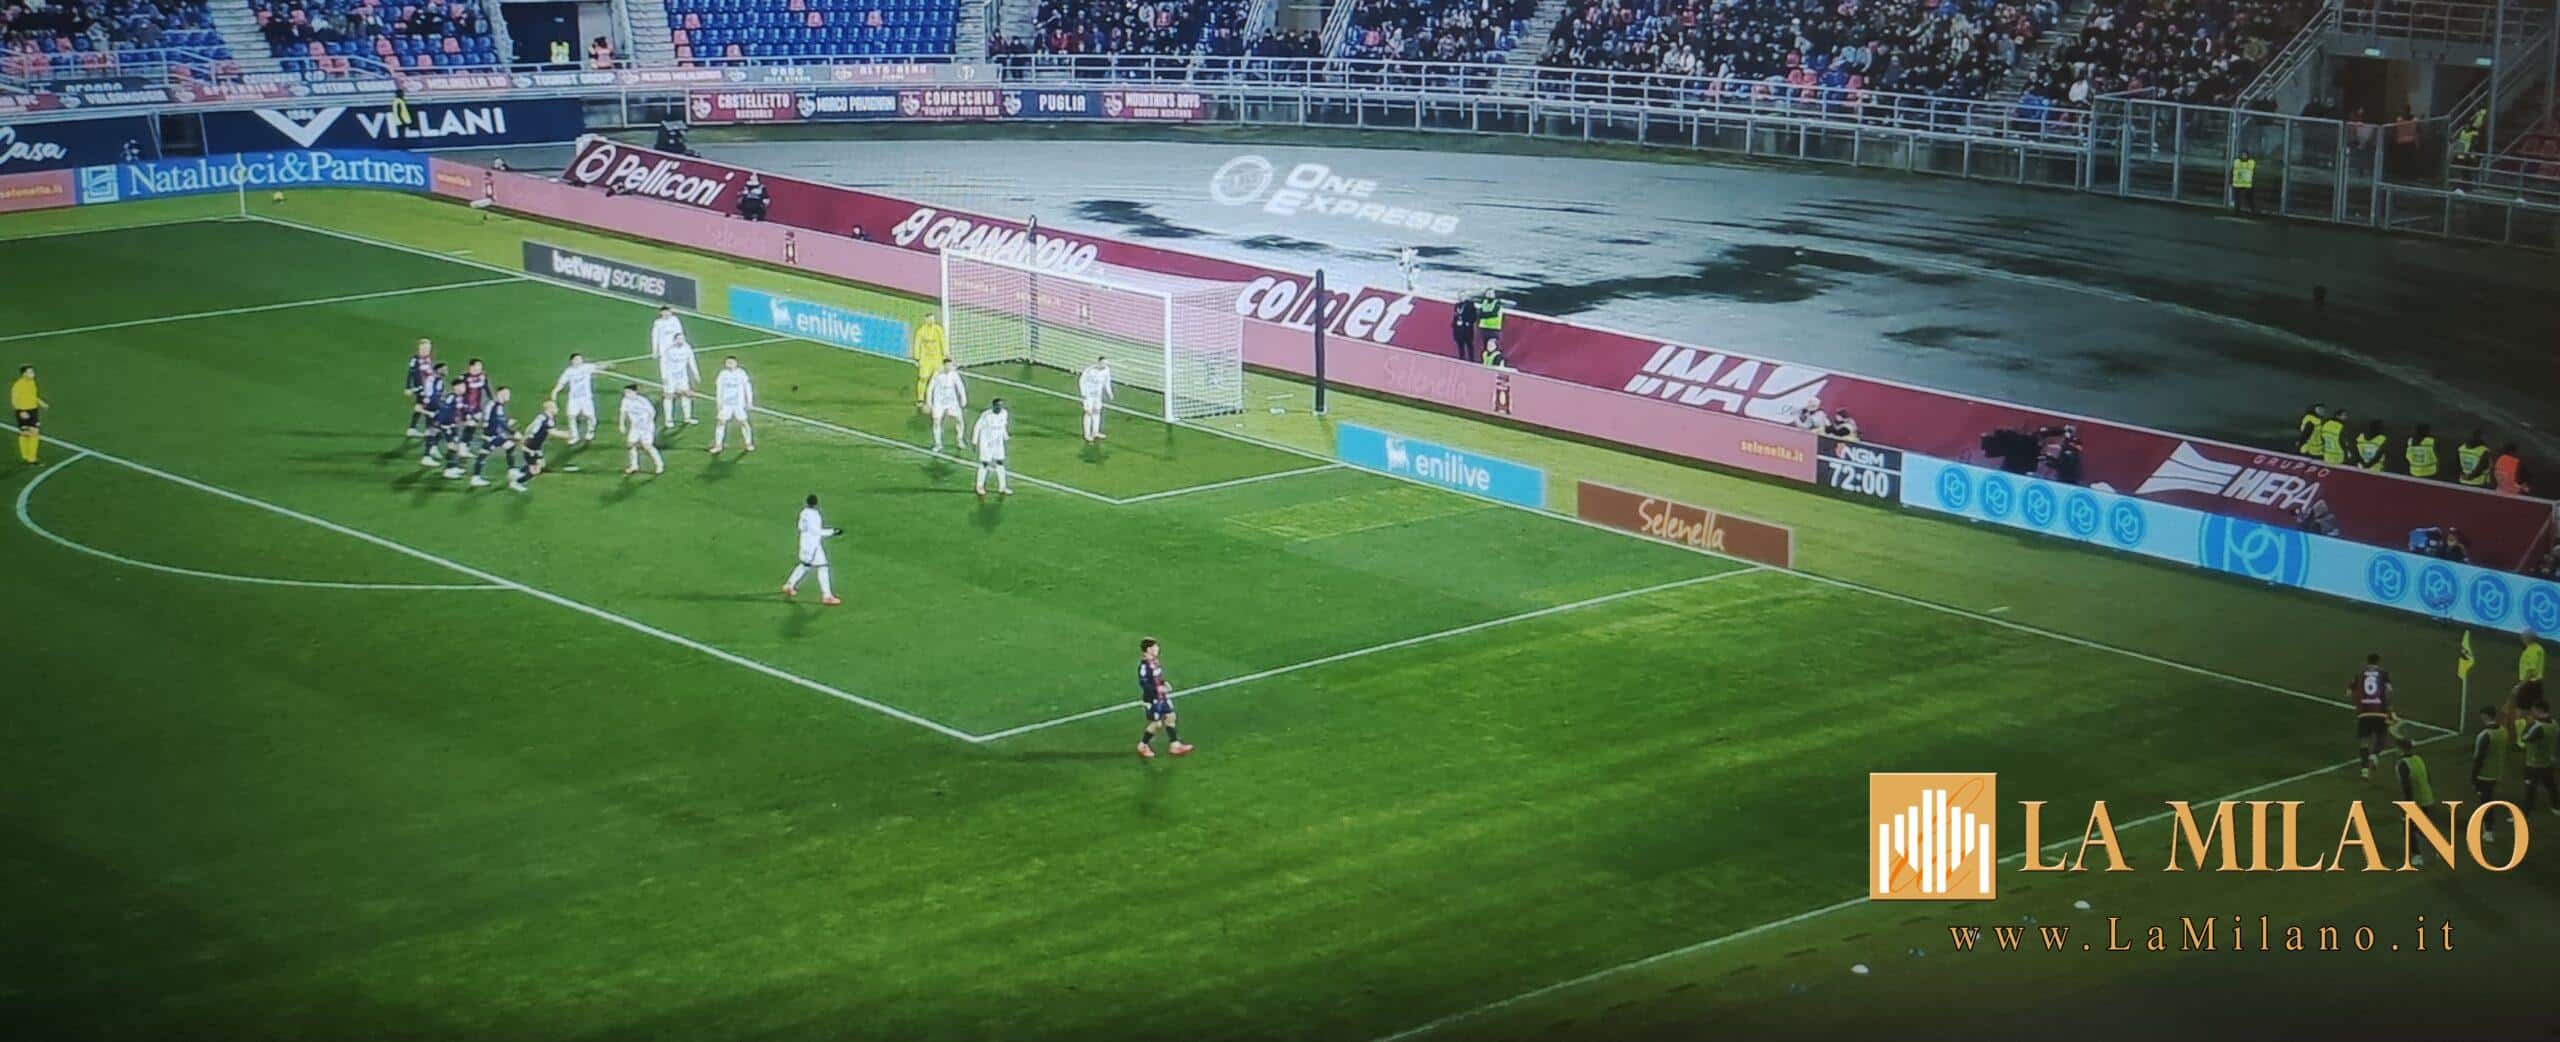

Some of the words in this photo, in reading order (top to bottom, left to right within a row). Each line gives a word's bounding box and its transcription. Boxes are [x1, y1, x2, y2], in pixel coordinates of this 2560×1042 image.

[717, 93, 791, 110] CASTELLETTO
[1038, 94, 1087, 113] PUGLIA
[128, 151, 426, 196] Natalucci&Partners
[605, 153, 735, 207] Pelliconi
[552, 249, 611, 289] betway
[611, 268, 666, 297] SCORES
[796, 310, 864, 343] enilive
[1416, 449, 1491, 492] enilive
[1843, 445, 1886, 468] NGM
[2253, 454, 2330, 478] GRUPPO
[1828, 461, 1890, 499] 72:00
[2222, 466, 2321, 513] HERA
[1638, 499, 1727, 552] Selenella
[2363, 676, 2378, 696] 6
